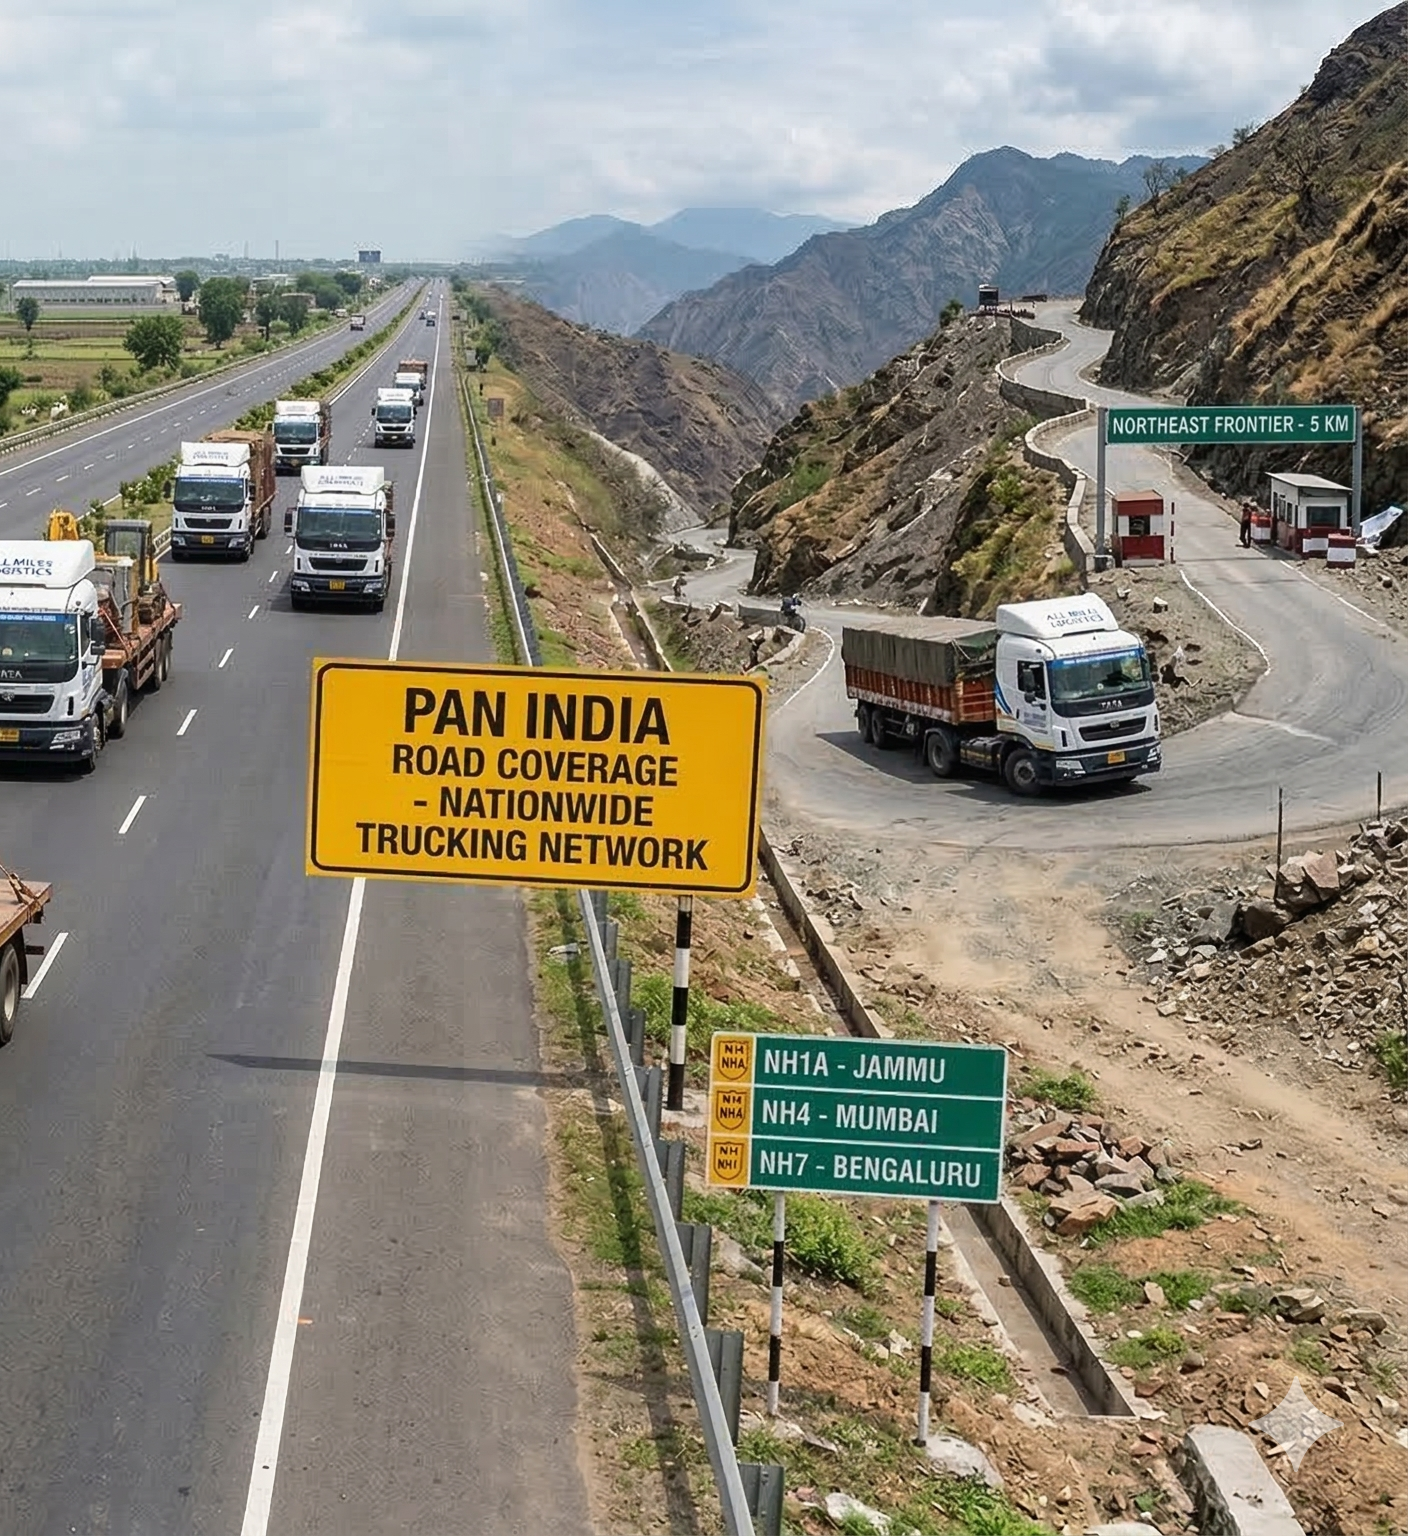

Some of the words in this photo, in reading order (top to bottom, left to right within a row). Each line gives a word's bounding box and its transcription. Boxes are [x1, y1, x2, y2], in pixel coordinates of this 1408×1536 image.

[1112, 416, 1210, 434] NORTHEAST
[1214, 415, 1293, 433] FRONTIER
[1310, 415, 1319, 432] 5
[1324, 414, 1349, 432] KM
[13, 558, 53, 567] MILES
[404, 687, 506, 738] PAN
[526, 691, 671, 745] INDIA
[392, 744, 485, 778] ROAD
[496, 748, 679, 787] COVERAGE
[439, 787, 654, 826] NATIONWIDE
[356, 821, 527, 862] TRUCKING
[539, 831, 709, 871] NETWORK
[721, 1057, 746, 1069] NHA
[724, 1044, 744, 1055] NH
[764, 1049, 829, 1077] NH1A
[853, 1053, 946, 1084] JAMMU
[719, 1107, 743, 1119] NHA
[762, 1099, 811, 1126] NH4
[835, 1104, 938, 1134] MUMBAI
[719, 1146, 739, 1156] NH
[760, 1150, 809, 1176] NH7
[833, 1154, 981, 1188] BENGALURU
